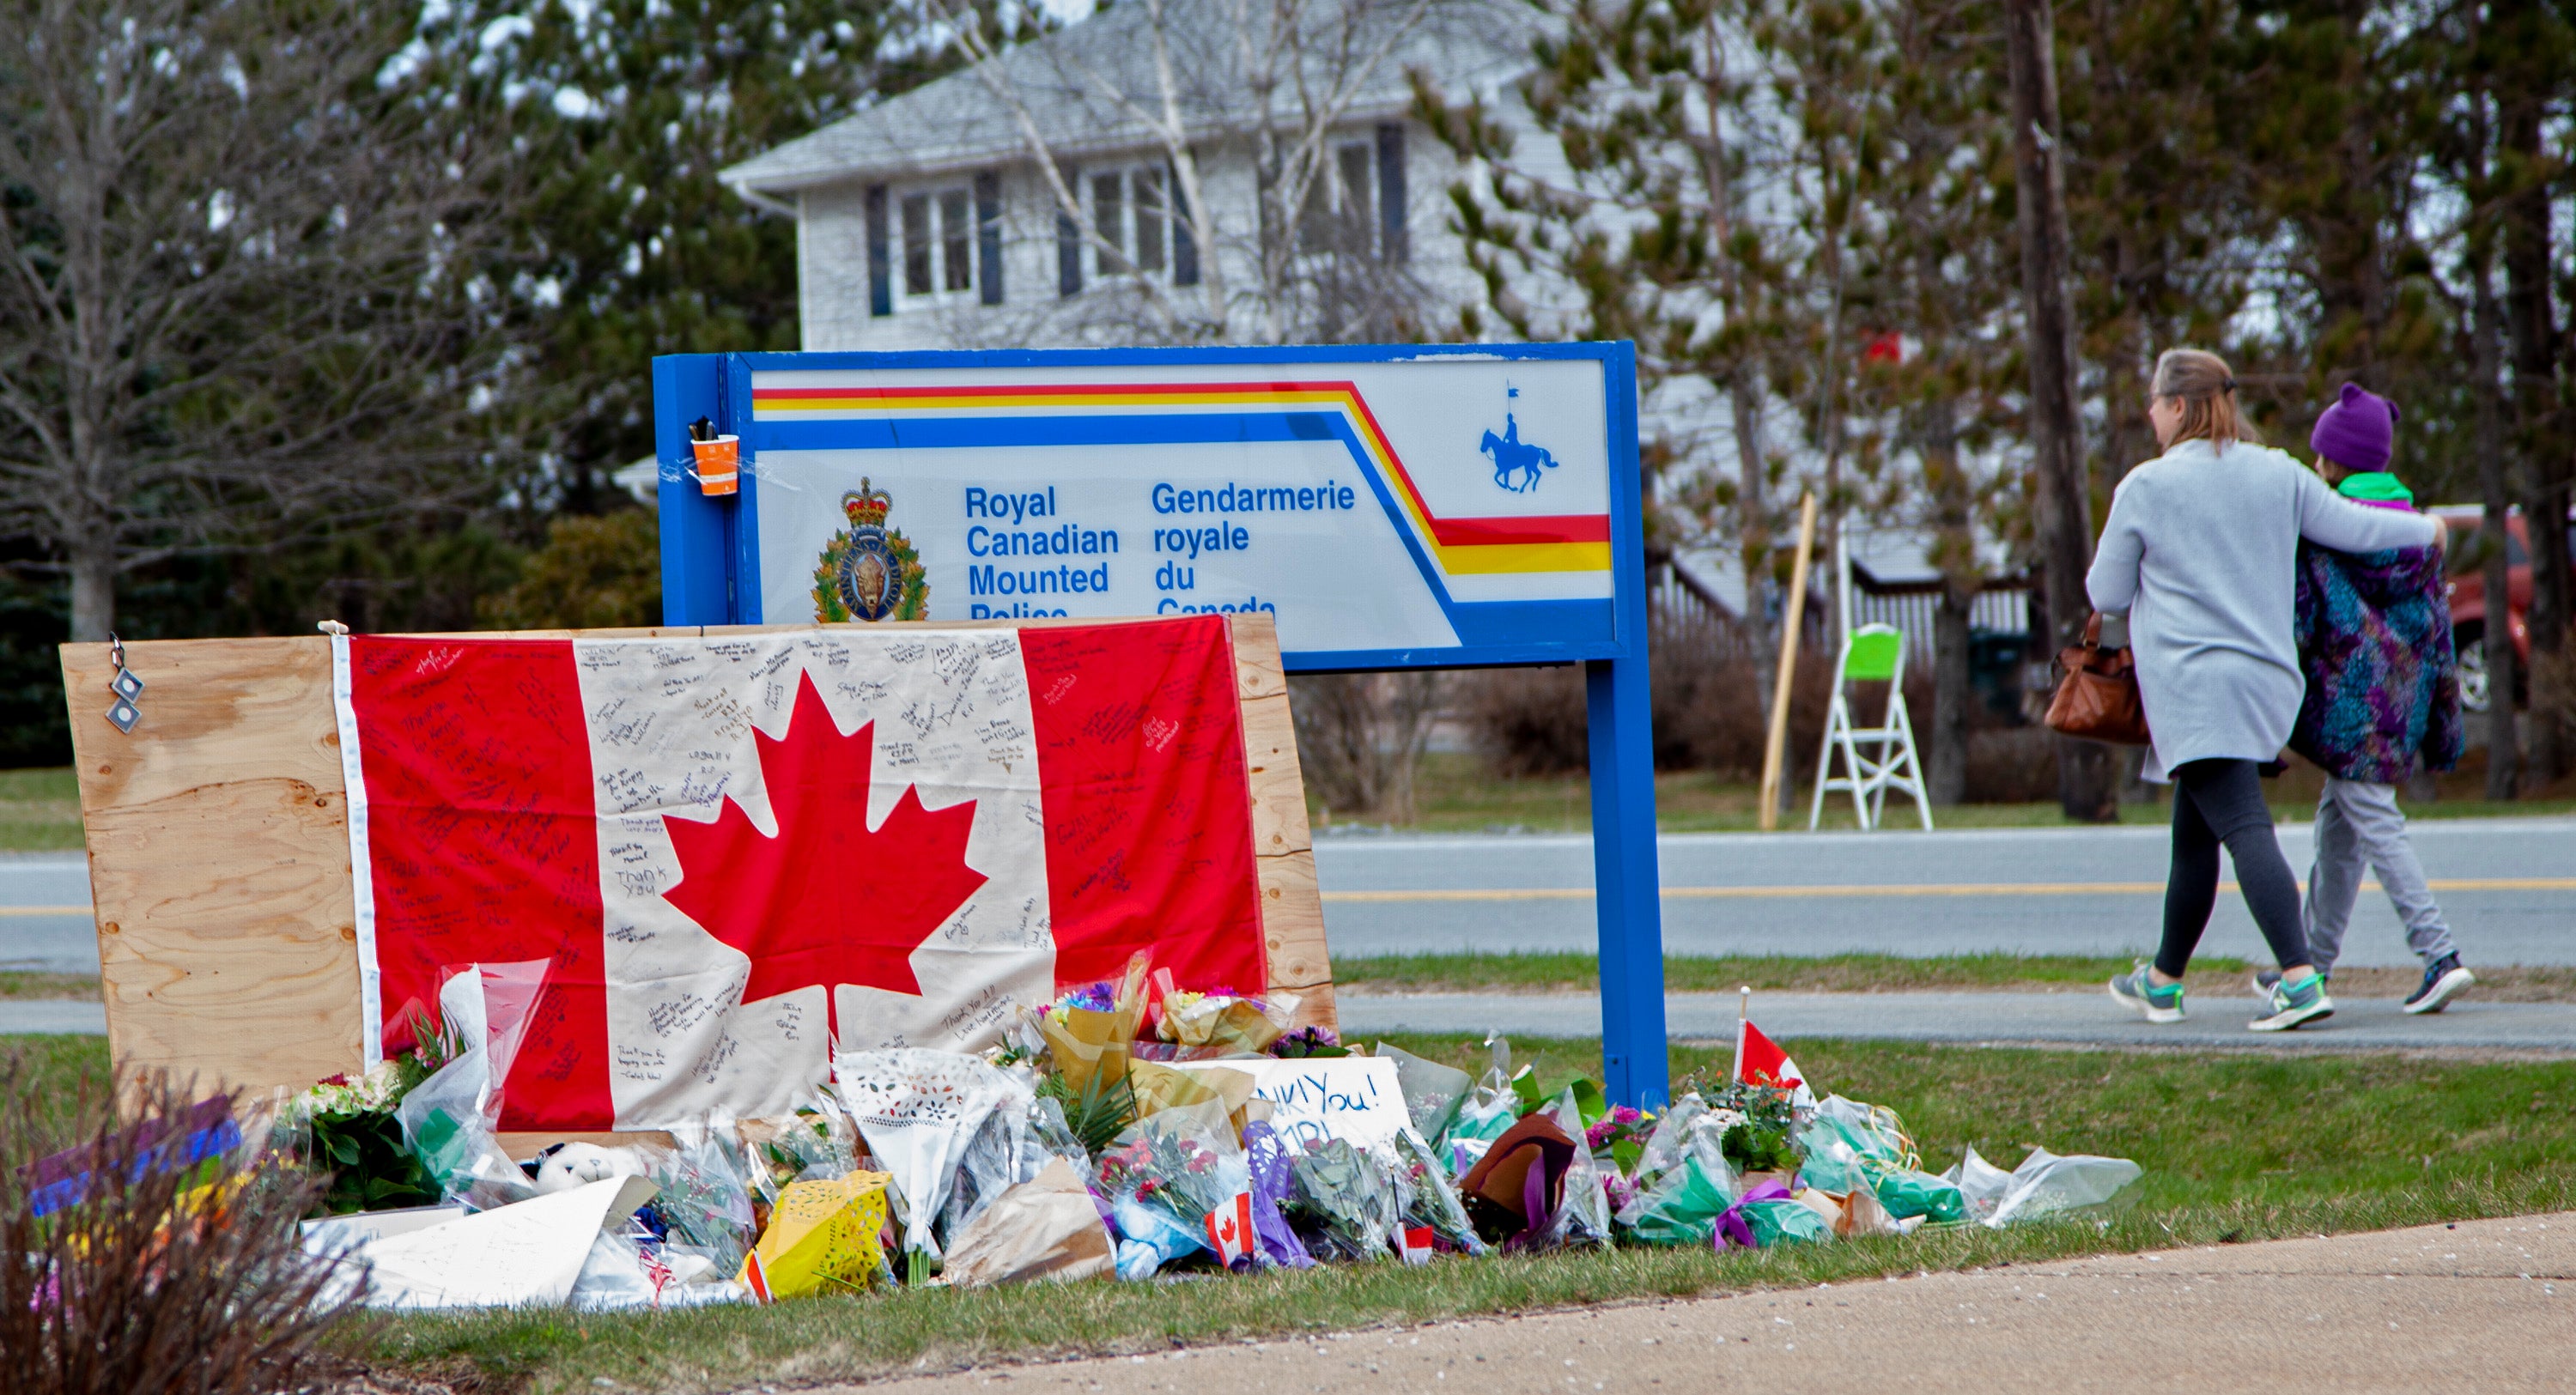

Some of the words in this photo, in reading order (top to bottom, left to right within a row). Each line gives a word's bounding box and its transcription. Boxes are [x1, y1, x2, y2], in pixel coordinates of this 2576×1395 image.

[965, 485, 1056, 525] Royal
[1151, 481, 1355, 514] Gendarmerie
[967, 524, 1119, 557] Canadian
[1154, 520, 1249, 560] royale
[969, 561, 1109, 596] Mounted
[1155, 560, 1194, 591] du
[615, 865, 667, 885] Thank
[623, 883, 656, 900] You
[942, 1005, 970, 1030] Thank
[969, 998, 983, 1012] You
[1303, 1072, 1380, 1115] You!
